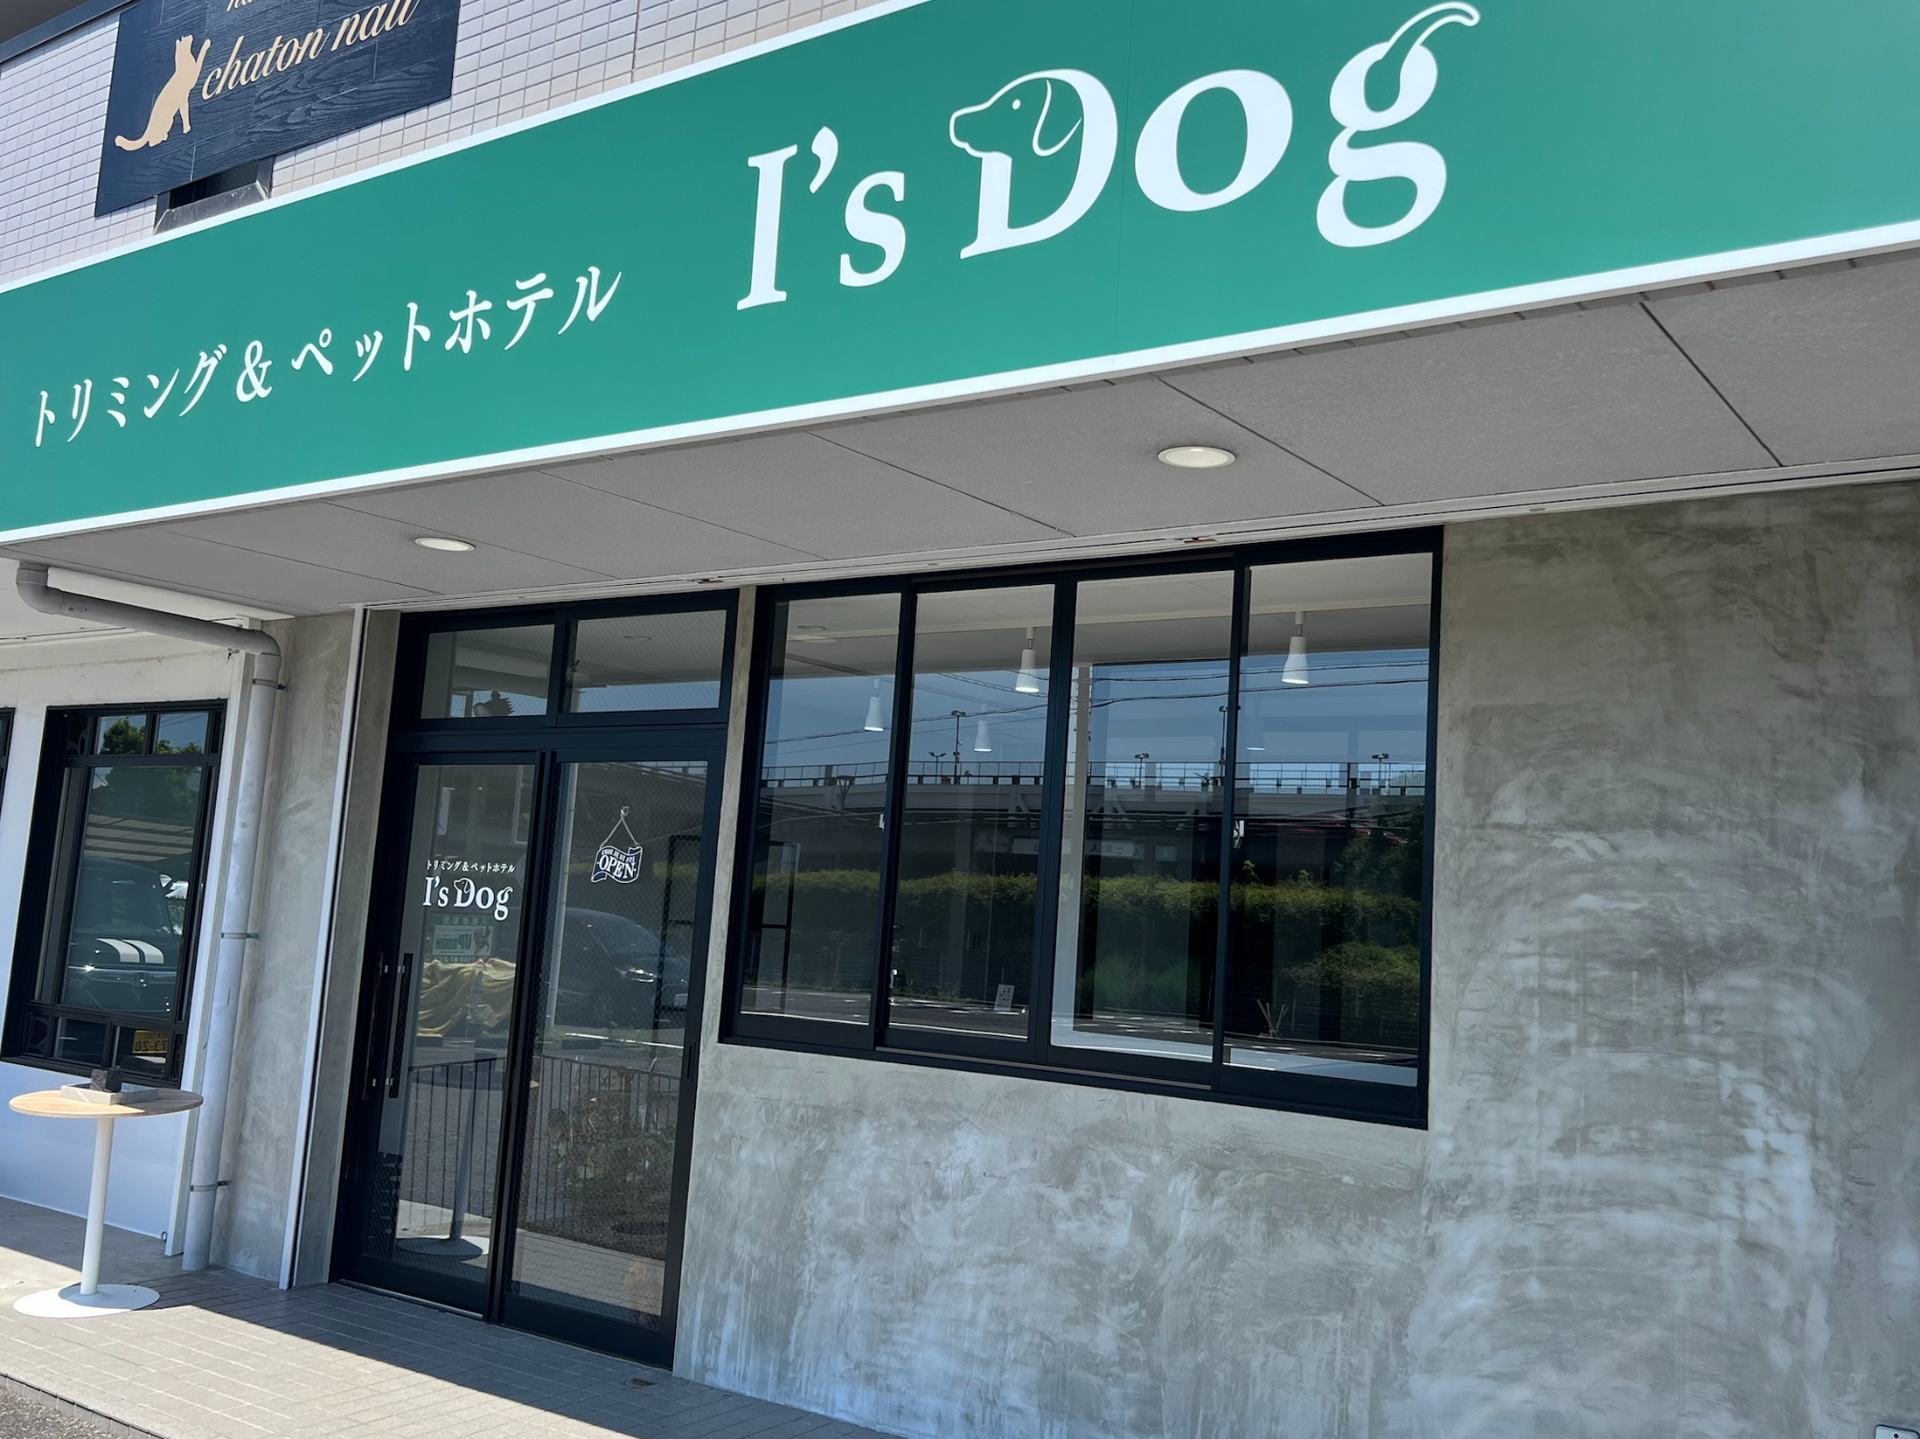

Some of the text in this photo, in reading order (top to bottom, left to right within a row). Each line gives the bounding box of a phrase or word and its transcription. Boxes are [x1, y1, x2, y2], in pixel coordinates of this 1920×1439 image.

[201, 28, 331, 100] chaton
[949, 1, 1481, 259] Dog
[600, 854, 636, 878] OPEN
[453, 877, 513, 921] Dog
